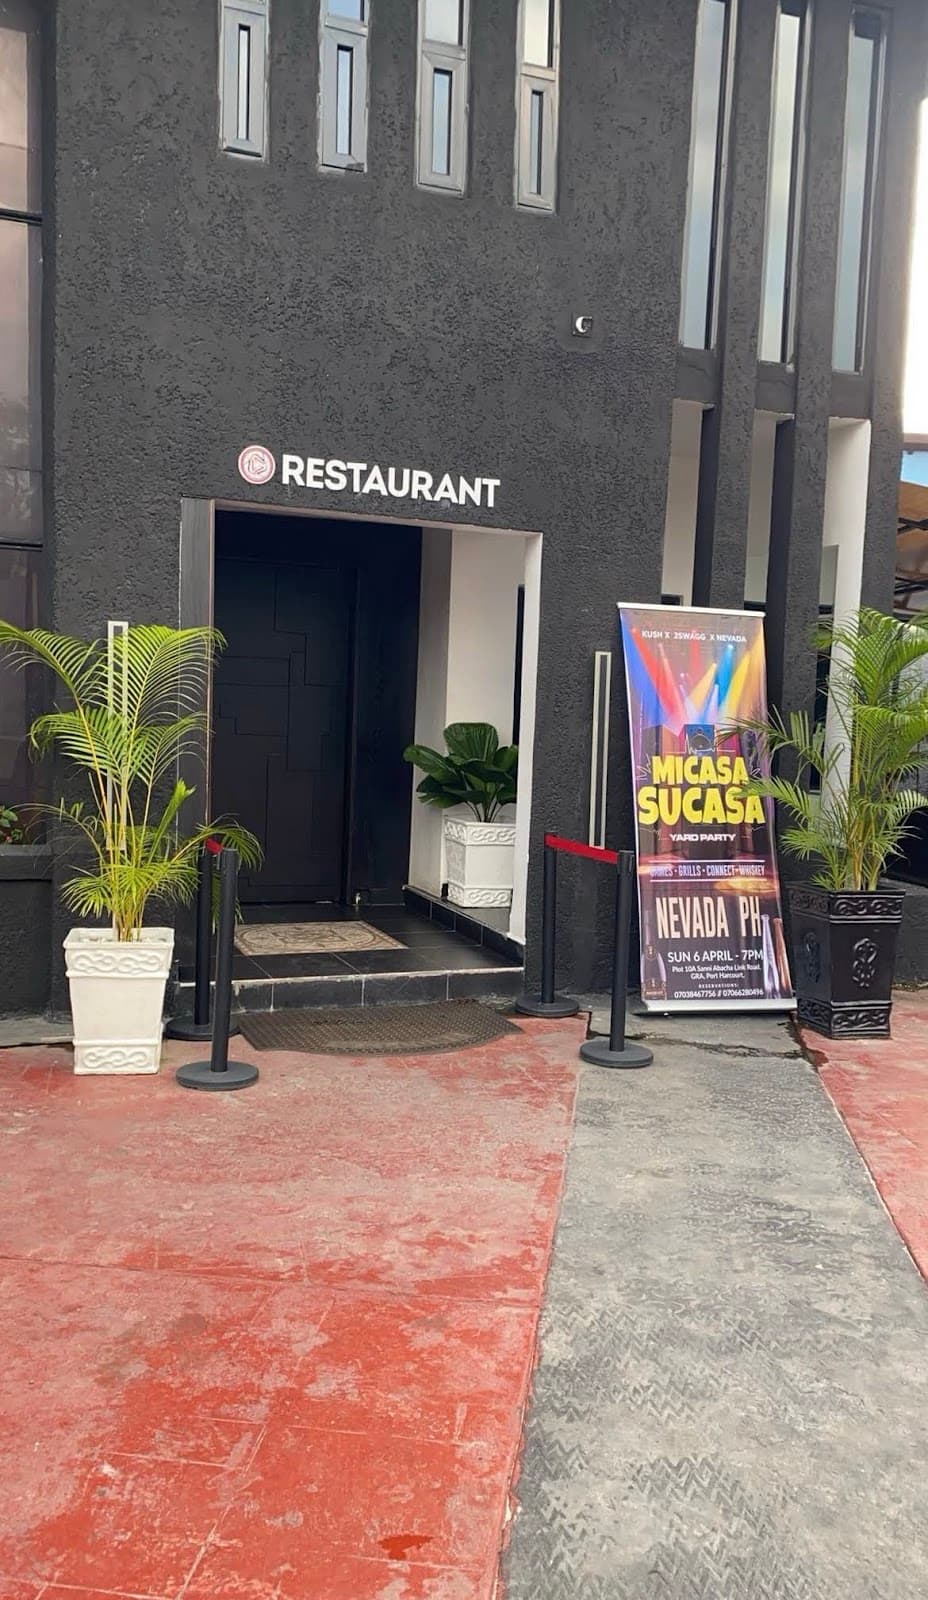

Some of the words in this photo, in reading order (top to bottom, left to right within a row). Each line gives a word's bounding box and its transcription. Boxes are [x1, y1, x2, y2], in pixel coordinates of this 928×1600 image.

[282, 454, 500, 507] RESTAURANT
[641, 630, 662, 639] KUSH
[665, 631, 670, 639] X
[710, 633, 715, 641] X
[717, 634, 746, 643] NEVADA
[652, 755, 749, 785] MICASA
[638, 786, 766, 825] SUCASA
[678, 865, 701, 876] GRILLS
[706, 865, 735, 876] CONNECT
[739, 865, 764, 876] WHISKEY
[655, 896, 729, 938] NEVADA
[739, 896, 761, 937] PH
[667, 952, 691, 962] SUN
[693, 952, 700, 961] 6
[702, 951, 733, 962] APRIL
[741, 950, 763, 961] 7PM
